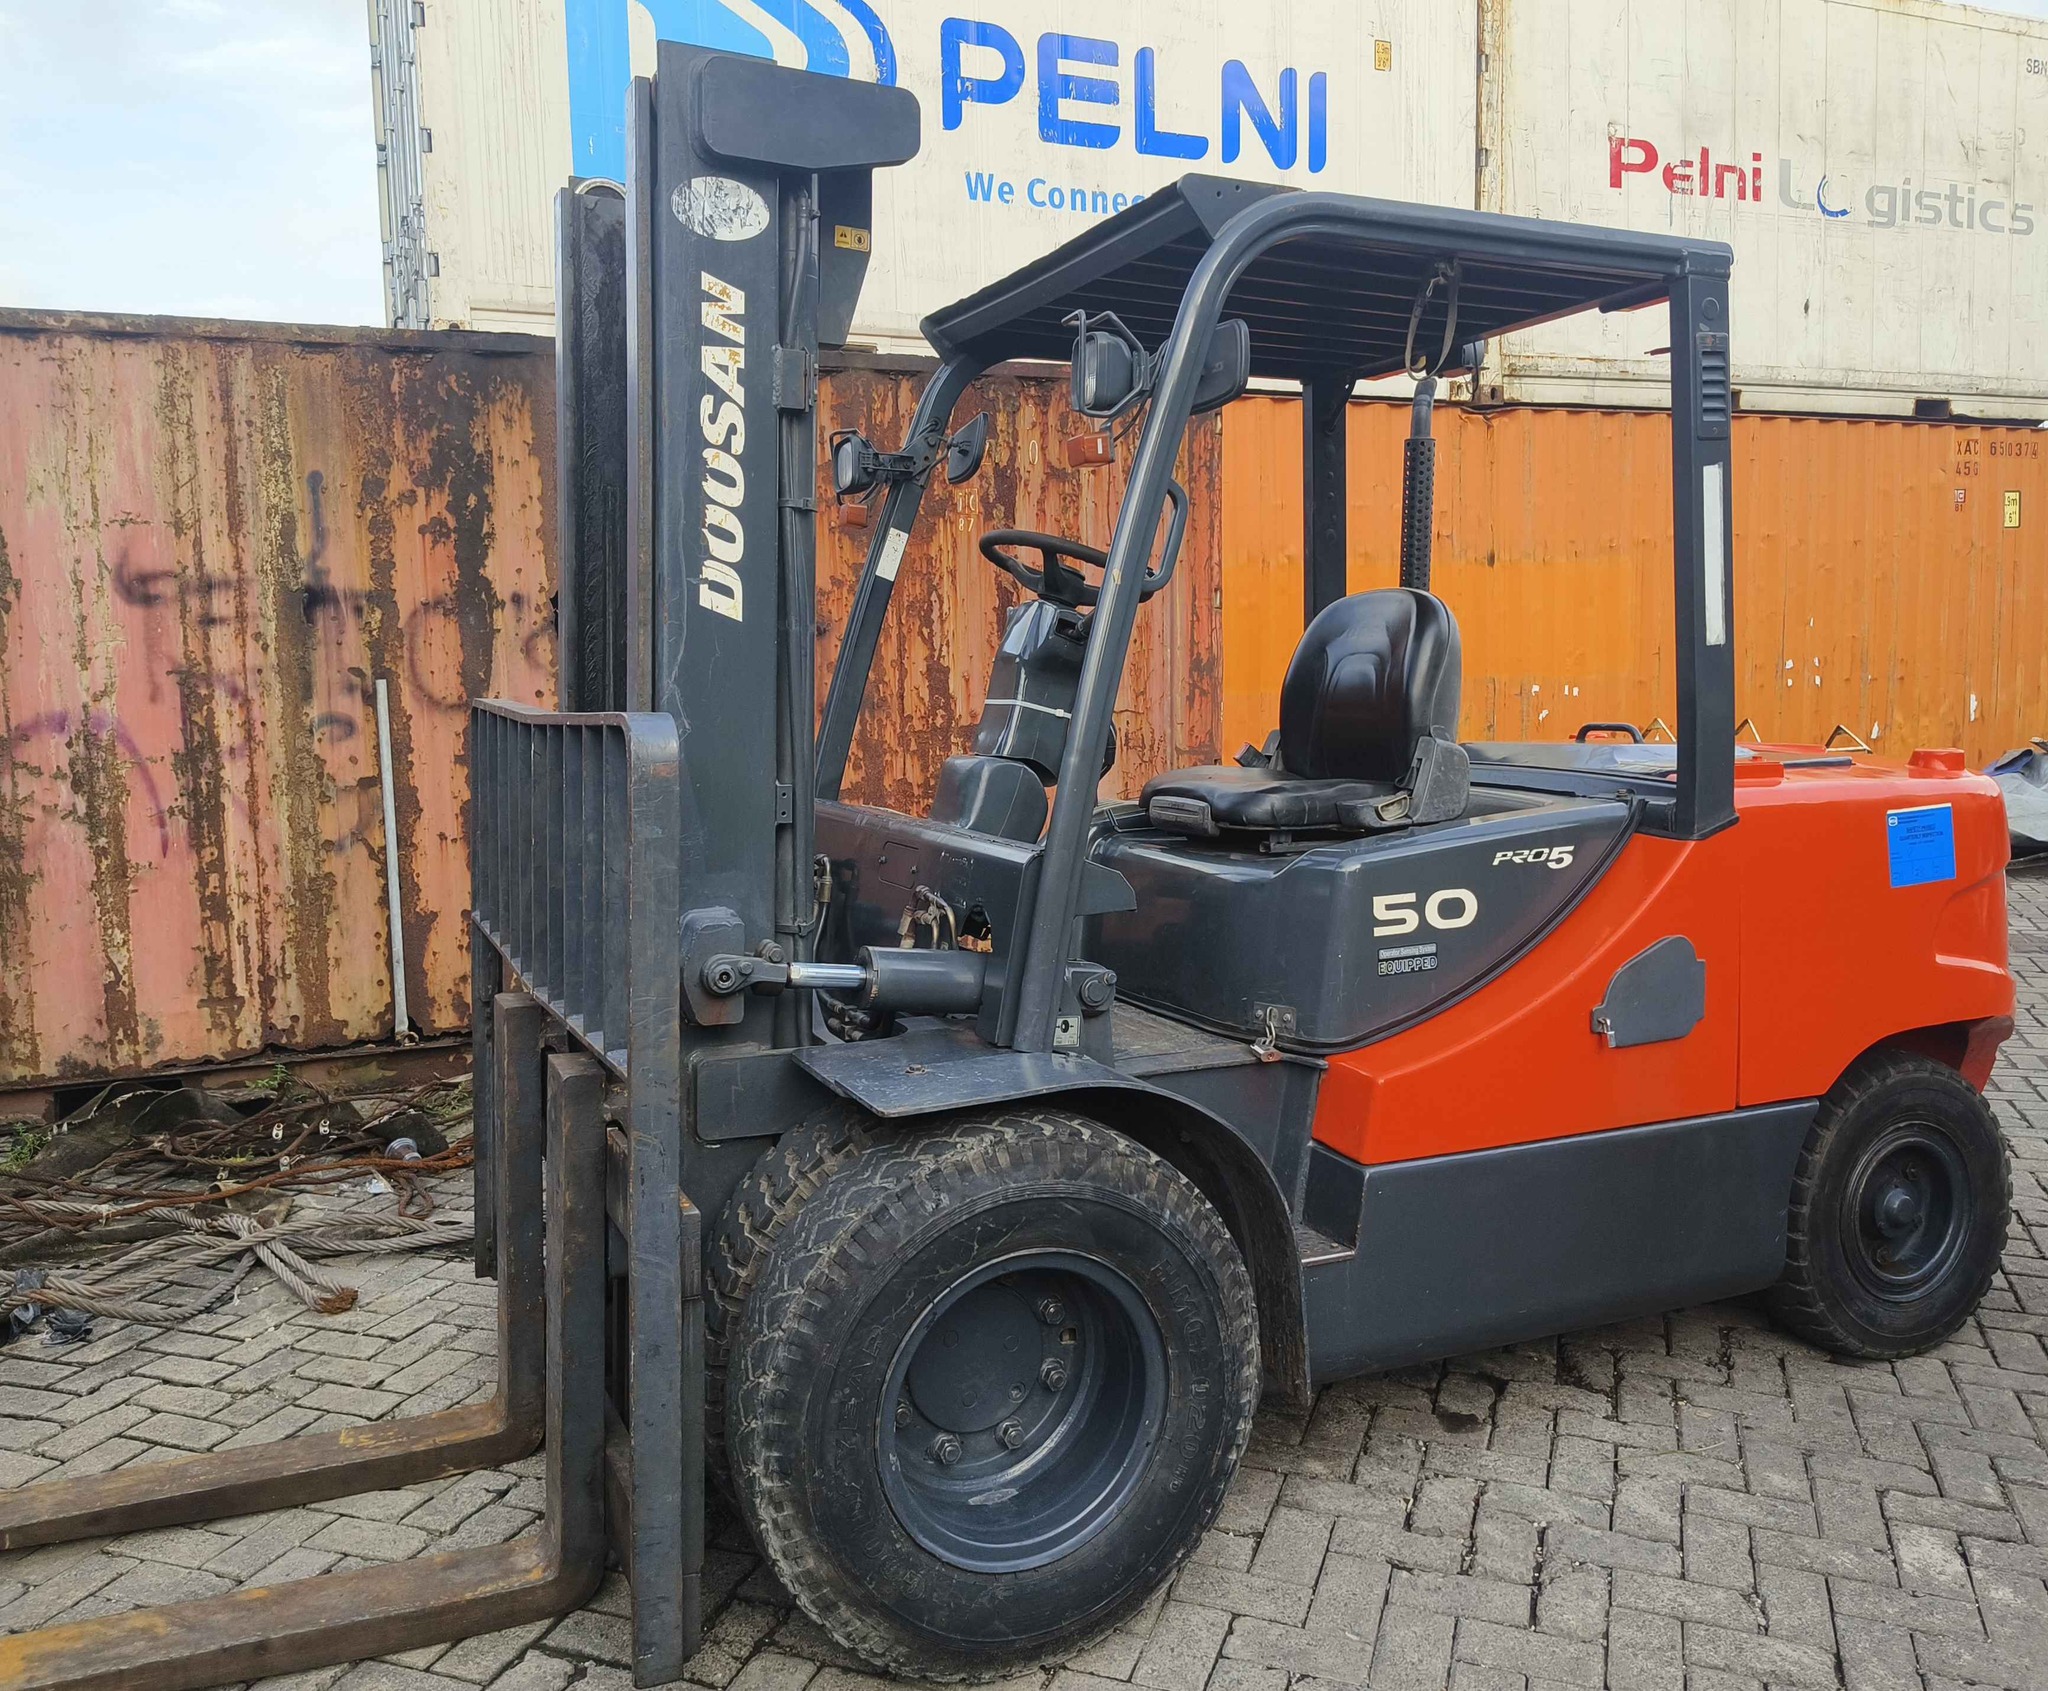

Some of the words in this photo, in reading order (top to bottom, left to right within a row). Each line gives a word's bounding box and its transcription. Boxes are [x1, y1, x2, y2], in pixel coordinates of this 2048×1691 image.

[941, 17, 1327, 174] PELNI
[965, 171, 1015, 204] We
[1608, 136, 1762, 202] Pelni
[700, 271, 746, 622] DOOSAN
[1373, 888, 1478, 937] 50
[1378, 955, 1438, 976] EQUIPPED
